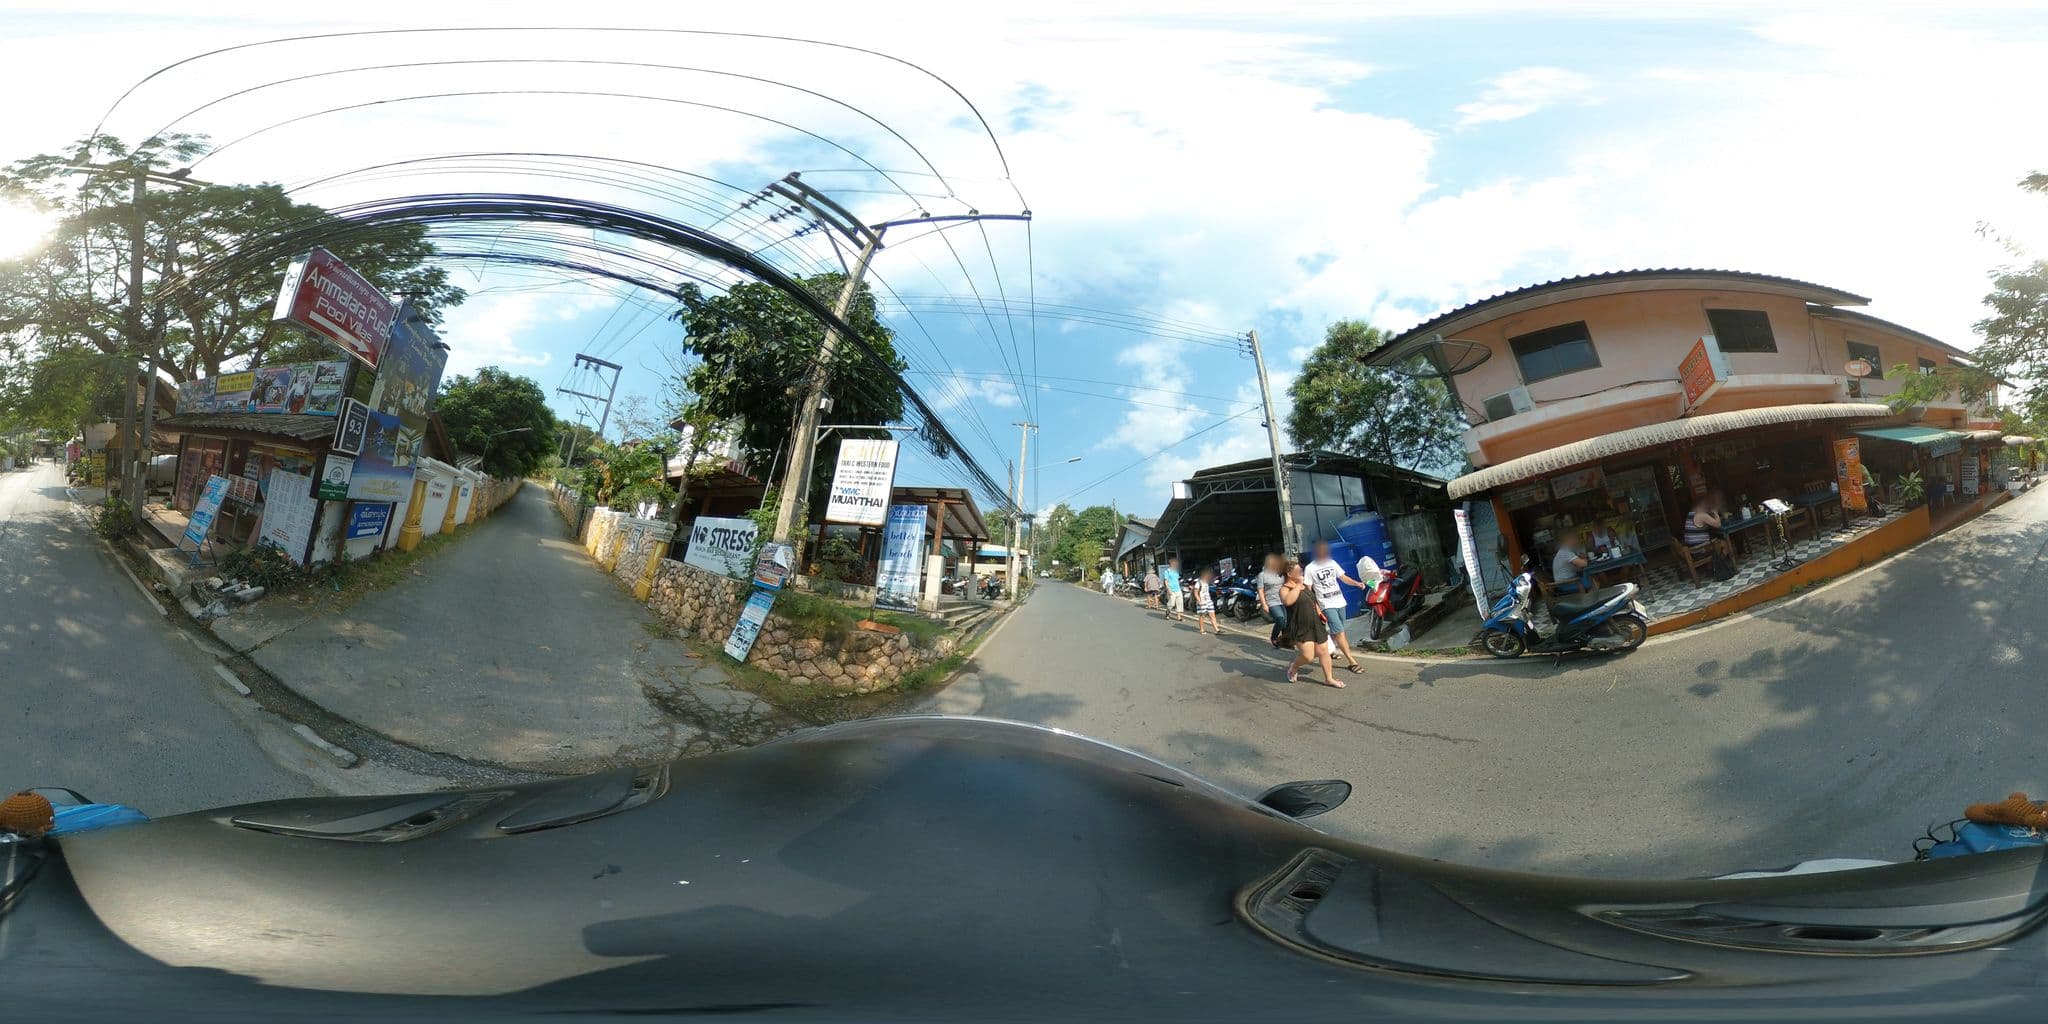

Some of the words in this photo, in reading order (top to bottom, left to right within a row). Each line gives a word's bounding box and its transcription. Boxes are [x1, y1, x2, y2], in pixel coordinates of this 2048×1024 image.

[305, 266, 368, 321] Ammatara
[366, 307, 387, 338] Pura
[316, 296, 347, 325] Pool
[349, 316, 373, 343] Villas
[348, 419, 362, 435] 9.3
[856, 460, 878, 468] WESTERN
[878, 461, 890, 469] FOOD
[841, 487, 861, 495] WMC
[831, 495, 884, 508] MUAYTHAI
[692, 525, 708, 544] NO
[709, 527, 754, 552] STRESS
